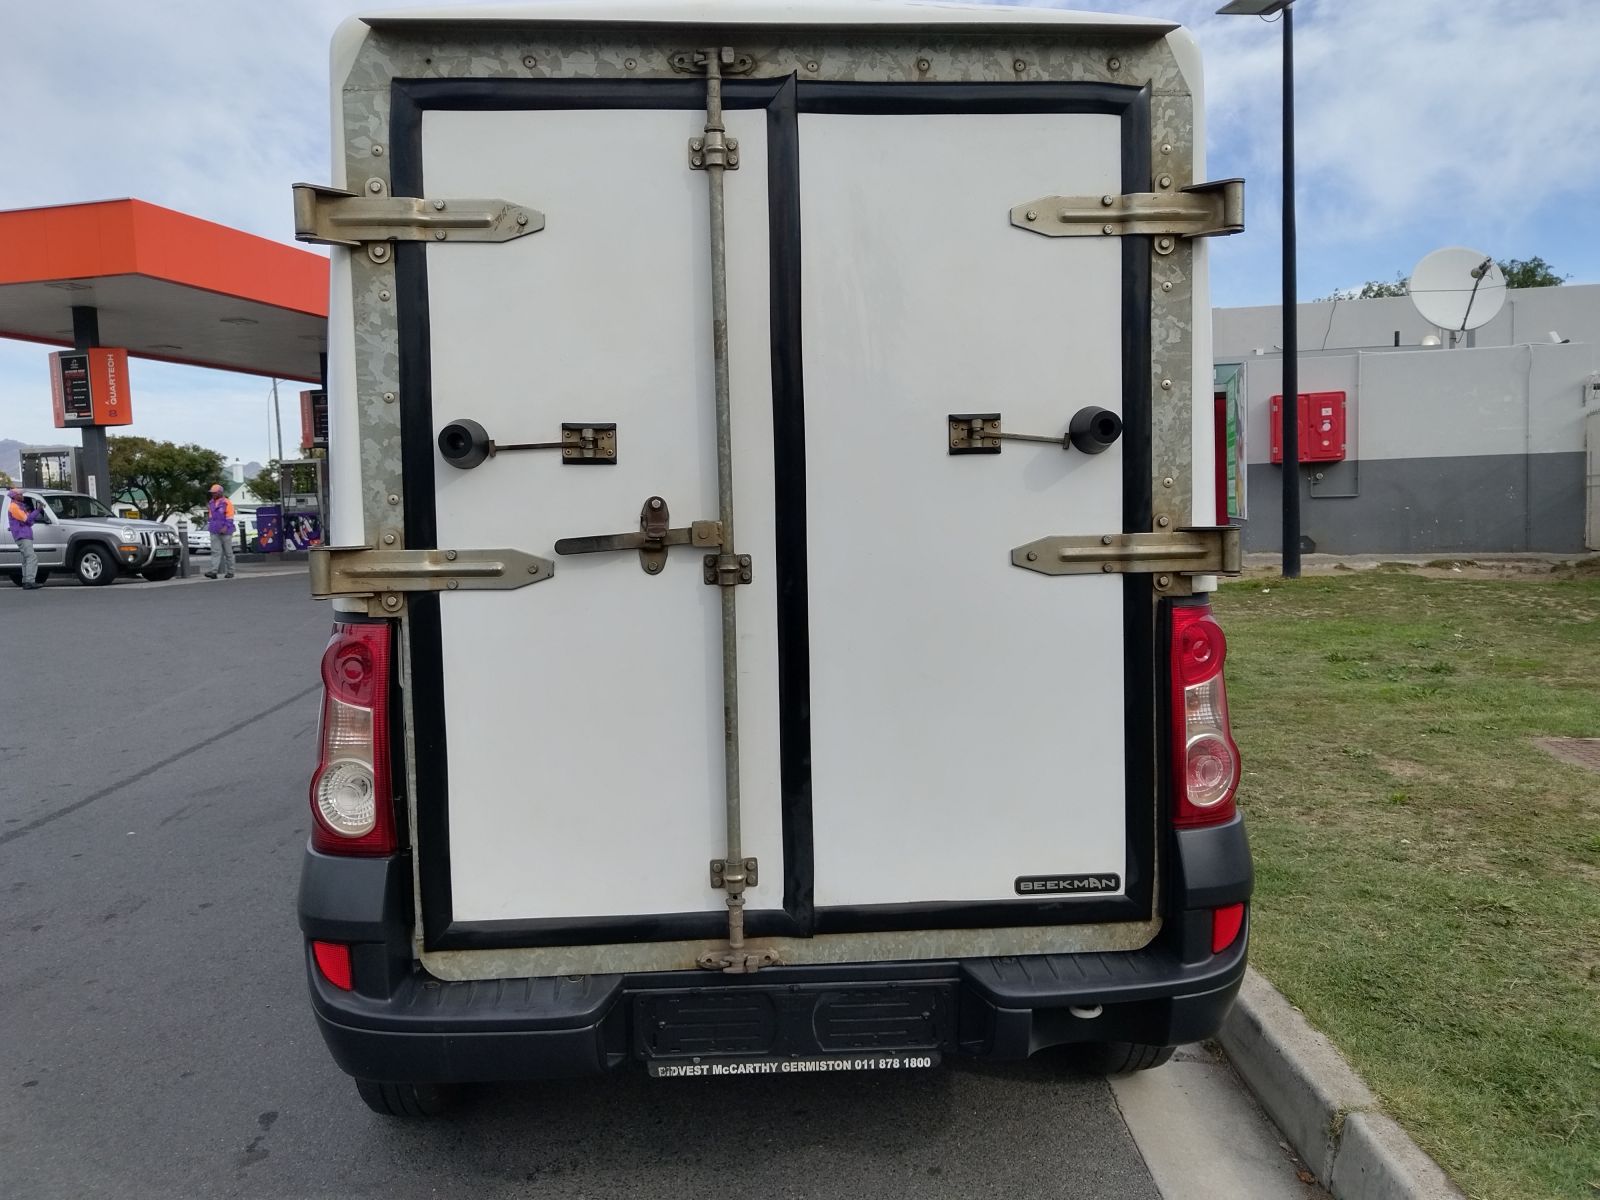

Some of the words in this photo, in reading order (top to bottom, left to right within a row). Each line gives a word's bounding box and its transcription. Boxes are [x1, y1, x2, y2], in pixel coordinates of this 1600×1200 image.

[107, 354, 117, 405] QUARTECH
[1020, 877, 1116, 891] BEEKMAN
[712, 1062, 779, 1075] McCARTHY
[781, 1060, 852, 1073] GERMISTON
[854, 1059, 875, 1070] 011
[879, 1058, 900, 1069] 878
[903, 1057, 931, 1068] 1800
